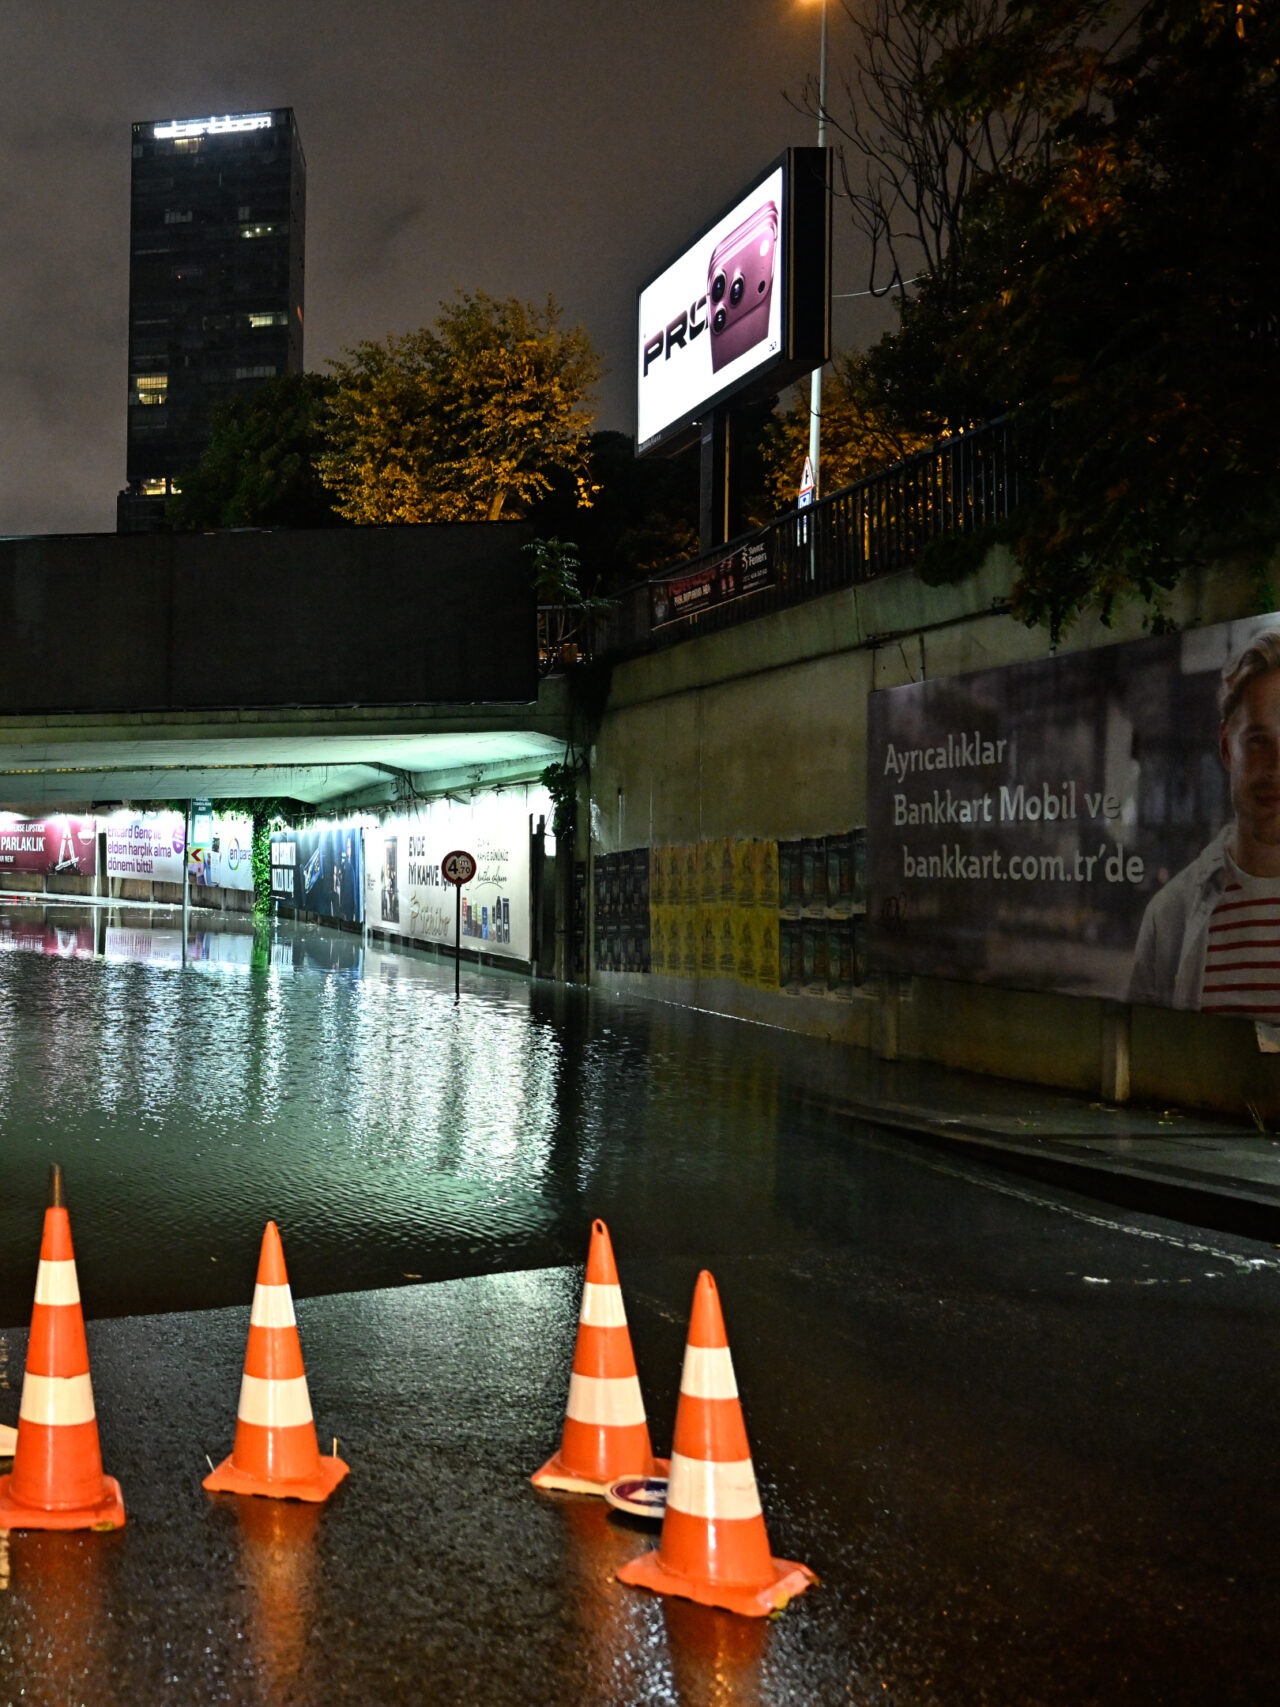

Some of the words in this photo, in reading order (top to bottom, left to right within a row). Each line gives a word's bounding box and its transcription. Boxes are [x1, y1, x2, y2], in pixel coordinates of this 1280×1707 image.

[884, 731, 1008, 783] Ayrıcalıklar
[894, 789, 993, 826] Bankkart
[999, 780, 1077, 822] Mobil
[1085, 792, 1122, 820] ve
[134, 825, 152, 841] Genç
[0, 836, 45, 852] PARLAKLIK
[107, 840, 128, 855] elden
[128, 841, 153, 858] harçlık
[153, 843, 172, 858] alma
[408, 836, 425, 857] EVDE
[107, 856, 135, 872] dönemi
[136, 858, 153, 874] bitti!
[448, 859, 459, 875] 4
[417, 865, 440, 887] KAHVE
